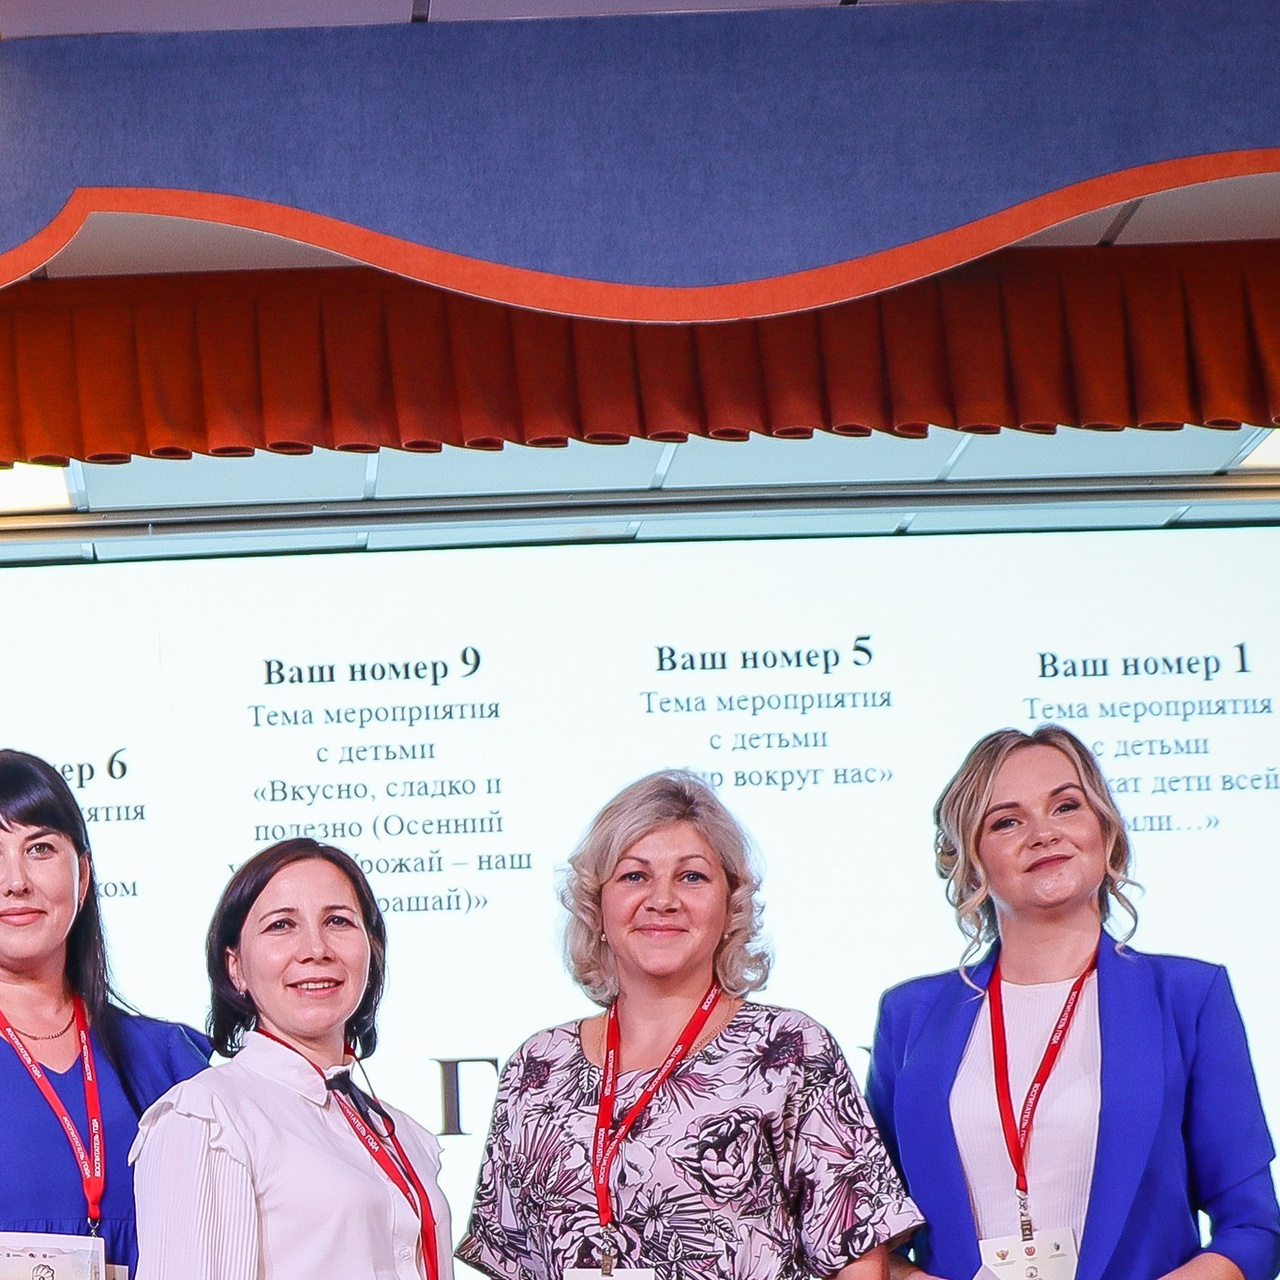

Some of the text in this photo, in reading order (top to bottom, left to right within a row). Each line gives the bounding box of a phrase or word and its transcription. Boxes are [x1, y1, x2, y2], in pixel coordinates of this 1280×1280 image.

[263, 646, 481, 686] Ваш номер 9
[655, 634, 872, 674] Ваш номер 5
[1038, 641, 1252, 681] Ваш номер 1
[247, 702, 501, 728] Тема мероприятия
[640, 691, 892, 716] Тема мероприятия
[1023, 697, 1273, 722] Тема мероприятия
[316, 743, 436, 765] с детьми
[710, 731, 828, 752] с детьми
[1092, 738, 1210, 758] с детьми
[107, 748, 127, 779] 6
[734, 769, 824, 791] вокруг
[833, 766, 894, 785] нас»
[1151, 775, 1212, 795] дети
[1221, 767, 1280, 791] всей
[253, 778, 502, 806] «Вкусно, сладко и
[254, 810, 504, 841] полезно (Осенний
[354, 849, 443, 874] рожай
[477, 853, 532, 871] наш
[377, 888, 489, 914] рашай)»
[364, 1134, 380, 1153] ГОДА
